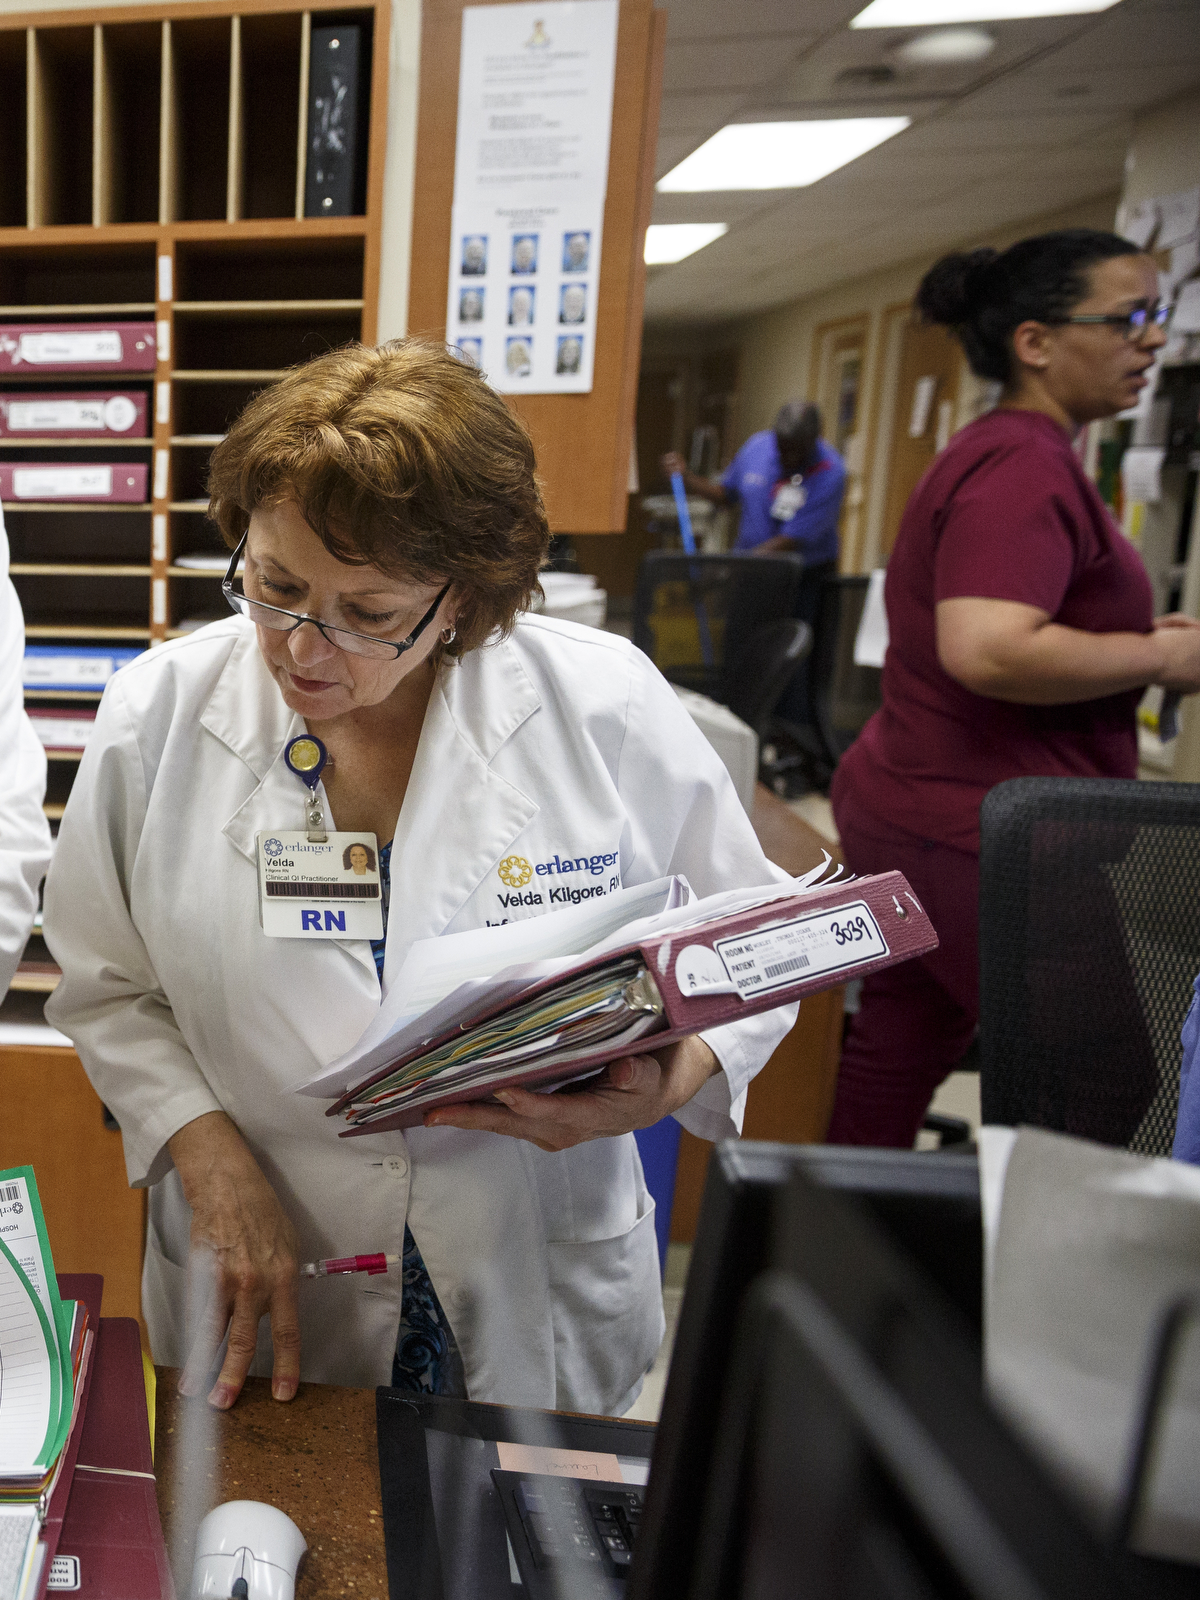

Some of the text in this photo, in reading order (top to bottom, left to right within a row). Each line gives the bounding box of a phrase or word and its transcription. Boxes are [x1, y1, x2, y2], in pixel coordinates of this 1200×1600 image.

[285, 842, 334, 856] erlanger
[264, 858, 295, 868] Velda
[535, 851, 619, 876] erlanger
[497, 891, 544, 908] Velda
[549, 886, 607, 904] Kilgore,
[301, 910, 347, 932] RN
[830, 916, 873, 946] 3039
[724, 947, 744, 958] ROOM
[731, 960, 756, 974] PATIENT
[736, 975, 762, 989] DOCTOR
